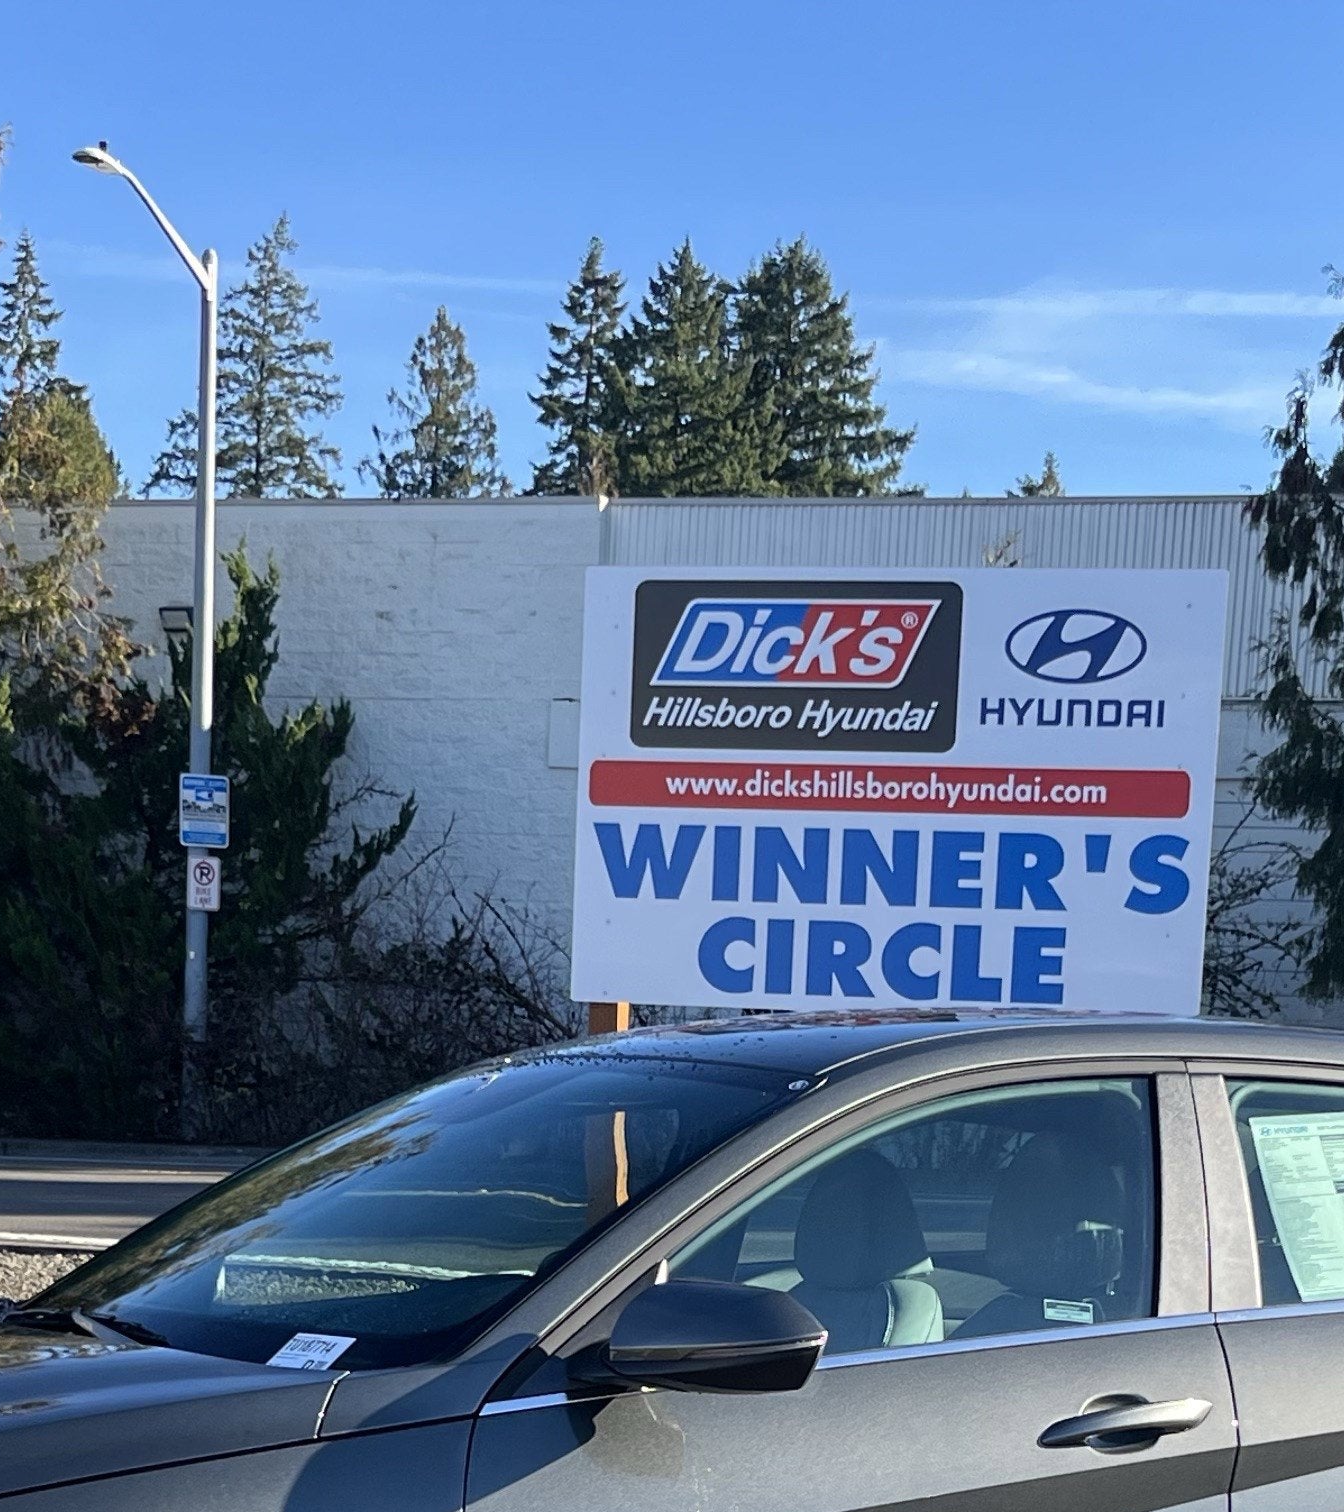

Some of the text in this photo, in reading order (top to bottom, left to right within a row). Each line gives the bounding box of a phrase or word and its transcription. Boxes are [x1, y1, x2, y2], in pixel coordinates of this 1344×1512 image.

[673, 609, 904, 676] Dick's
[642, 697, 939, 738] Hillsboro Hyundai
[980, 697, 1166, 728] HYUNDAI
[665, 770, 1107, 810] www.dickshillsborohyundai.com
[593, 822, 1191, 915] WINNER'S
[697, 916, 1068, 1005] CIRCLE
